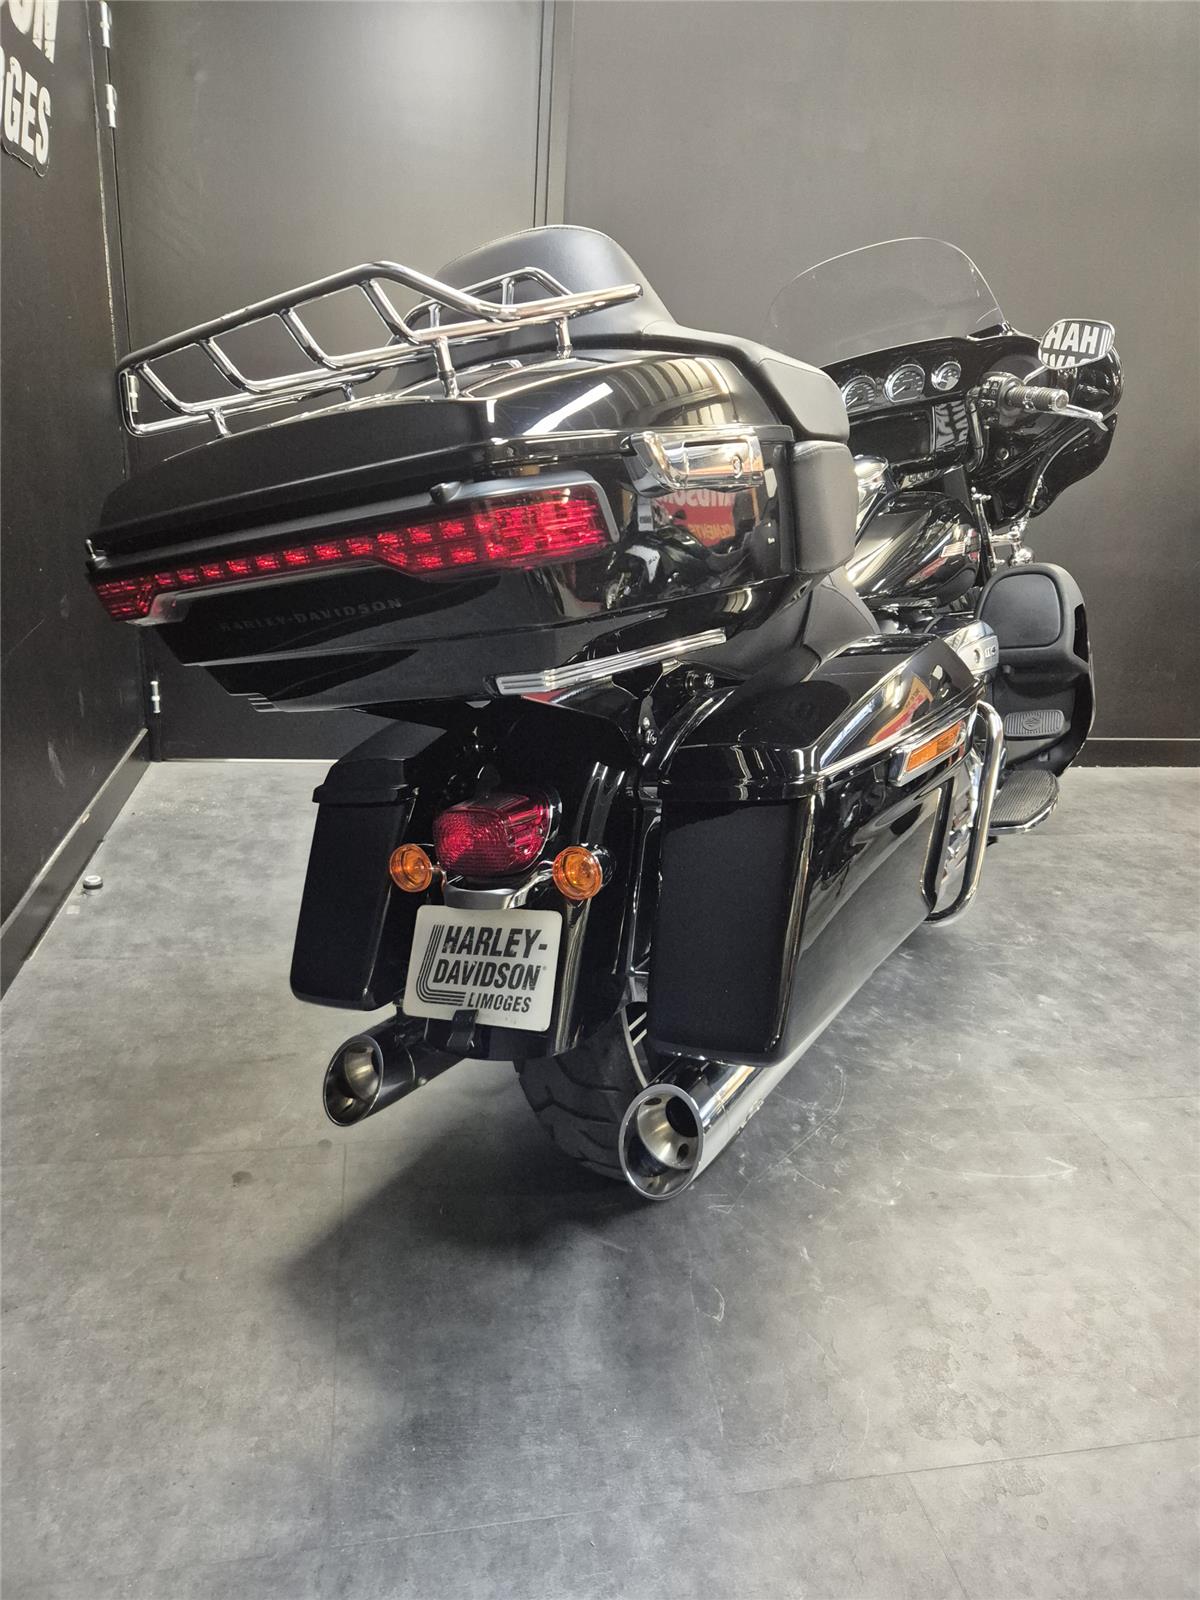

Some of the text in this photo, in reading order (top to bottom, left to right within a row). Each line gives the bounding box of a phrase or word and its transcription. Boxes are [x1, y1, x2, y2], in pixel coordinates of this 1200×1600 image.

[0, 46, 51, 165] GES
[441, 925, 548, 959] HARLEY-
[432, 959, 542, 991] DAVIDSON
[467, 992, 532, 1013] LIMOGES
